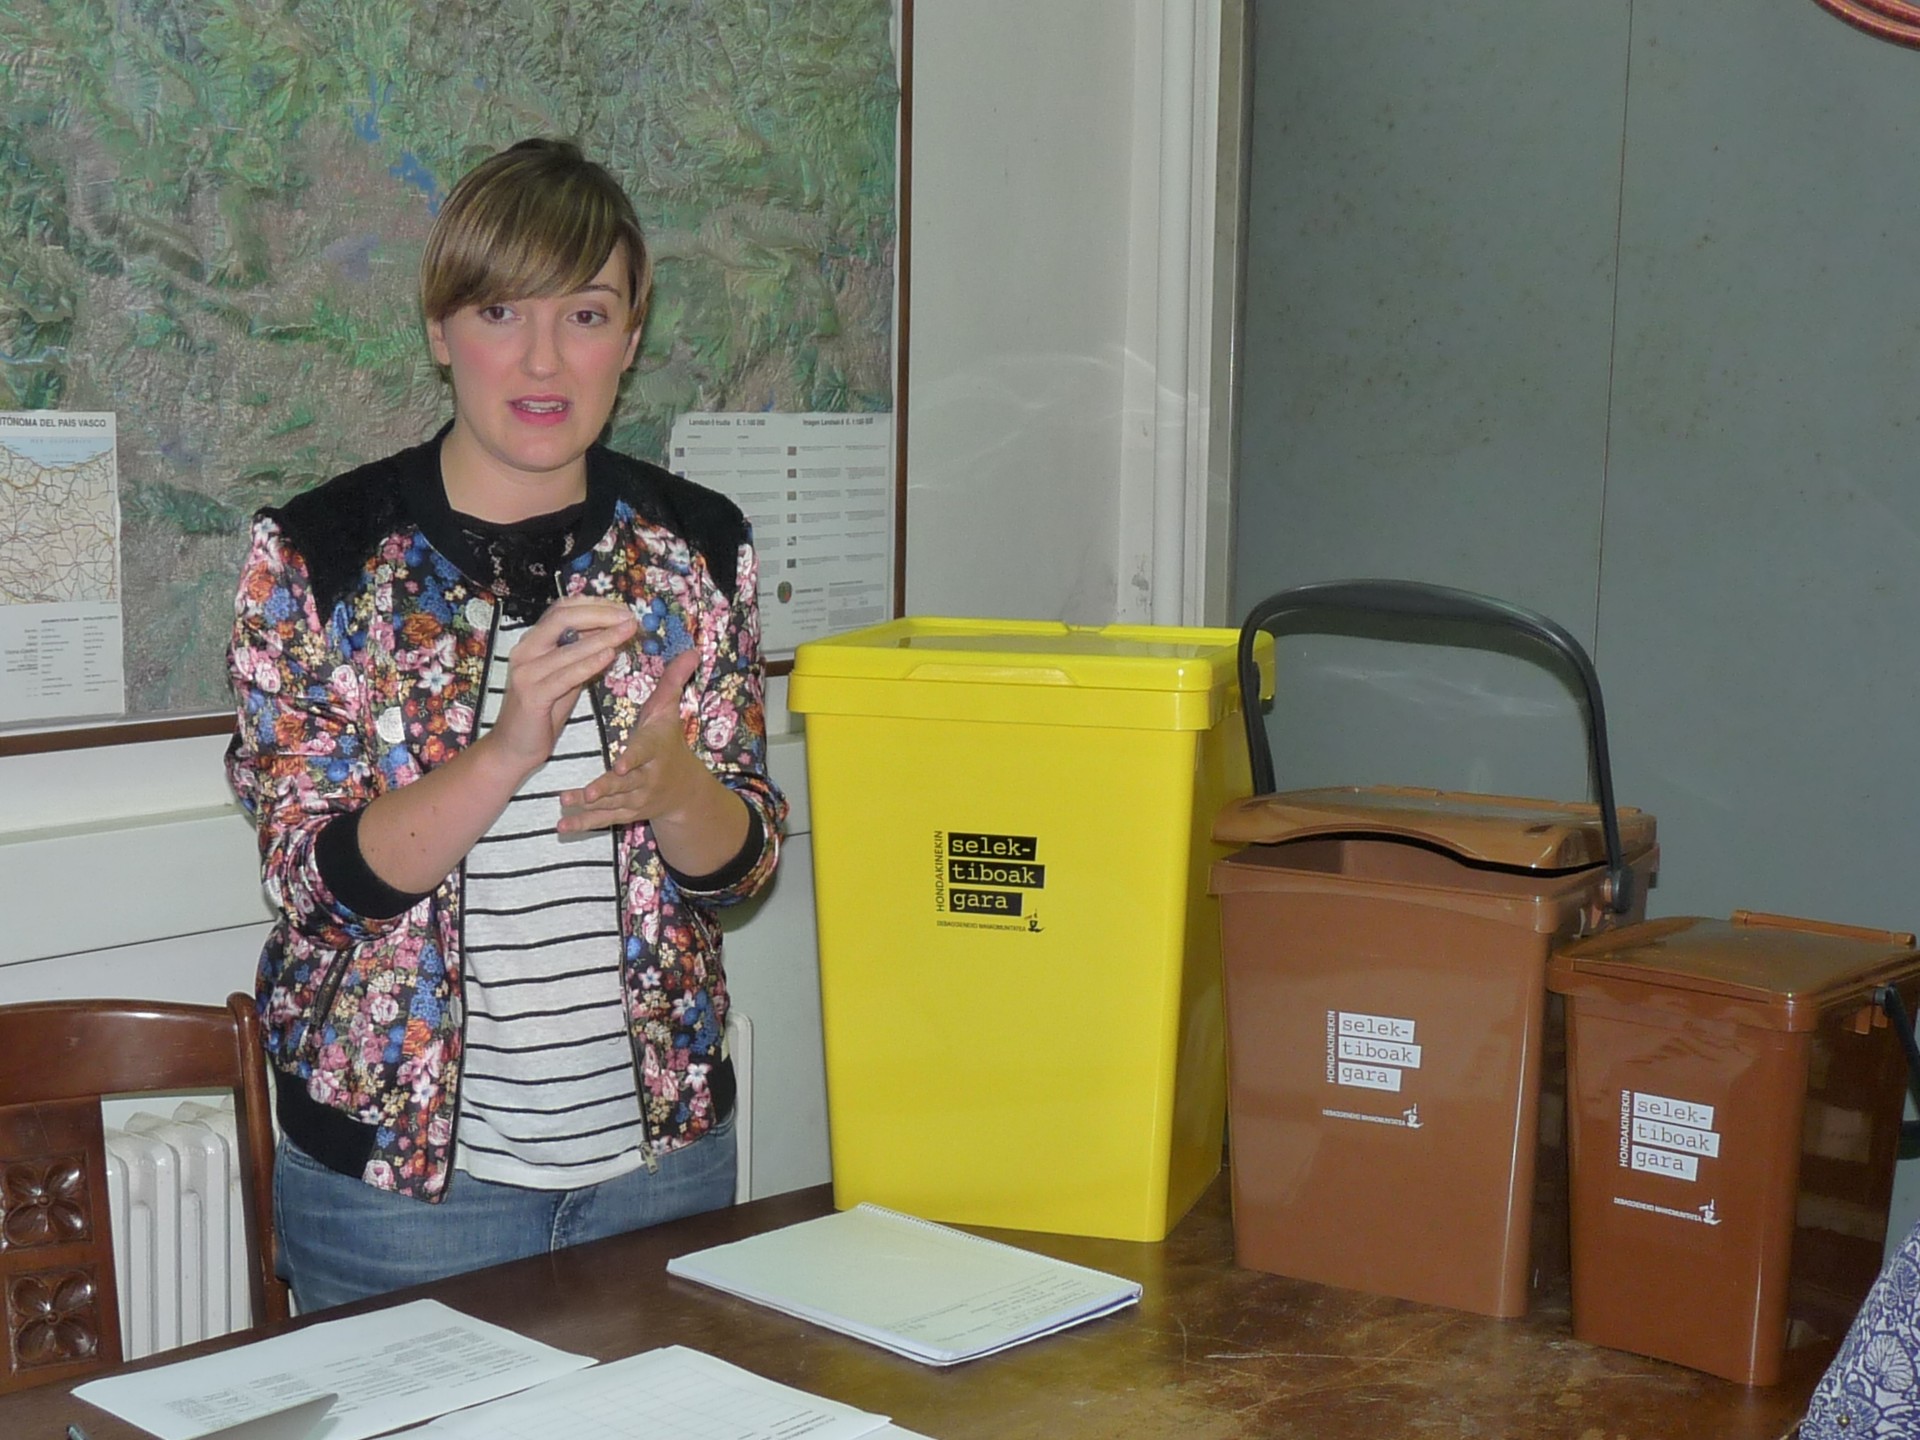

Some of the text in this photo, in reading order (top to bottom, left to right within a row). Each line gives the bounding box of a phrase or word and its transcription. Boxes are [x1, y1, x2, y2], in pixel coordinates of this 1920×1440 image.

[39, 418, 56, 428] DEL
[78, 418, 107, 428] VASCO
[951, 836, 1032, 856] selek-
[934, 830, 945, 912] HONDAKINEKIN
[951, 862, 1036, 884] tiboak
[953, 893, 1009, 910] gara
[1342, 1018, 1409, 1037] selek-
[1327, 1010, 1336, 1083] HONDAKINEKIN
[1342, 1040, 1413, 1063] tiboak
[1342, 1066, 1389, 1083] gara
[1637, 1100, 1707, 1123] selek-
[1620, 1090, 1630, 1168] HONDAKINEKIN
[1636, 1122, 1710, 1151] tiboak
[1635, 1150, 1685, 1172] gara
